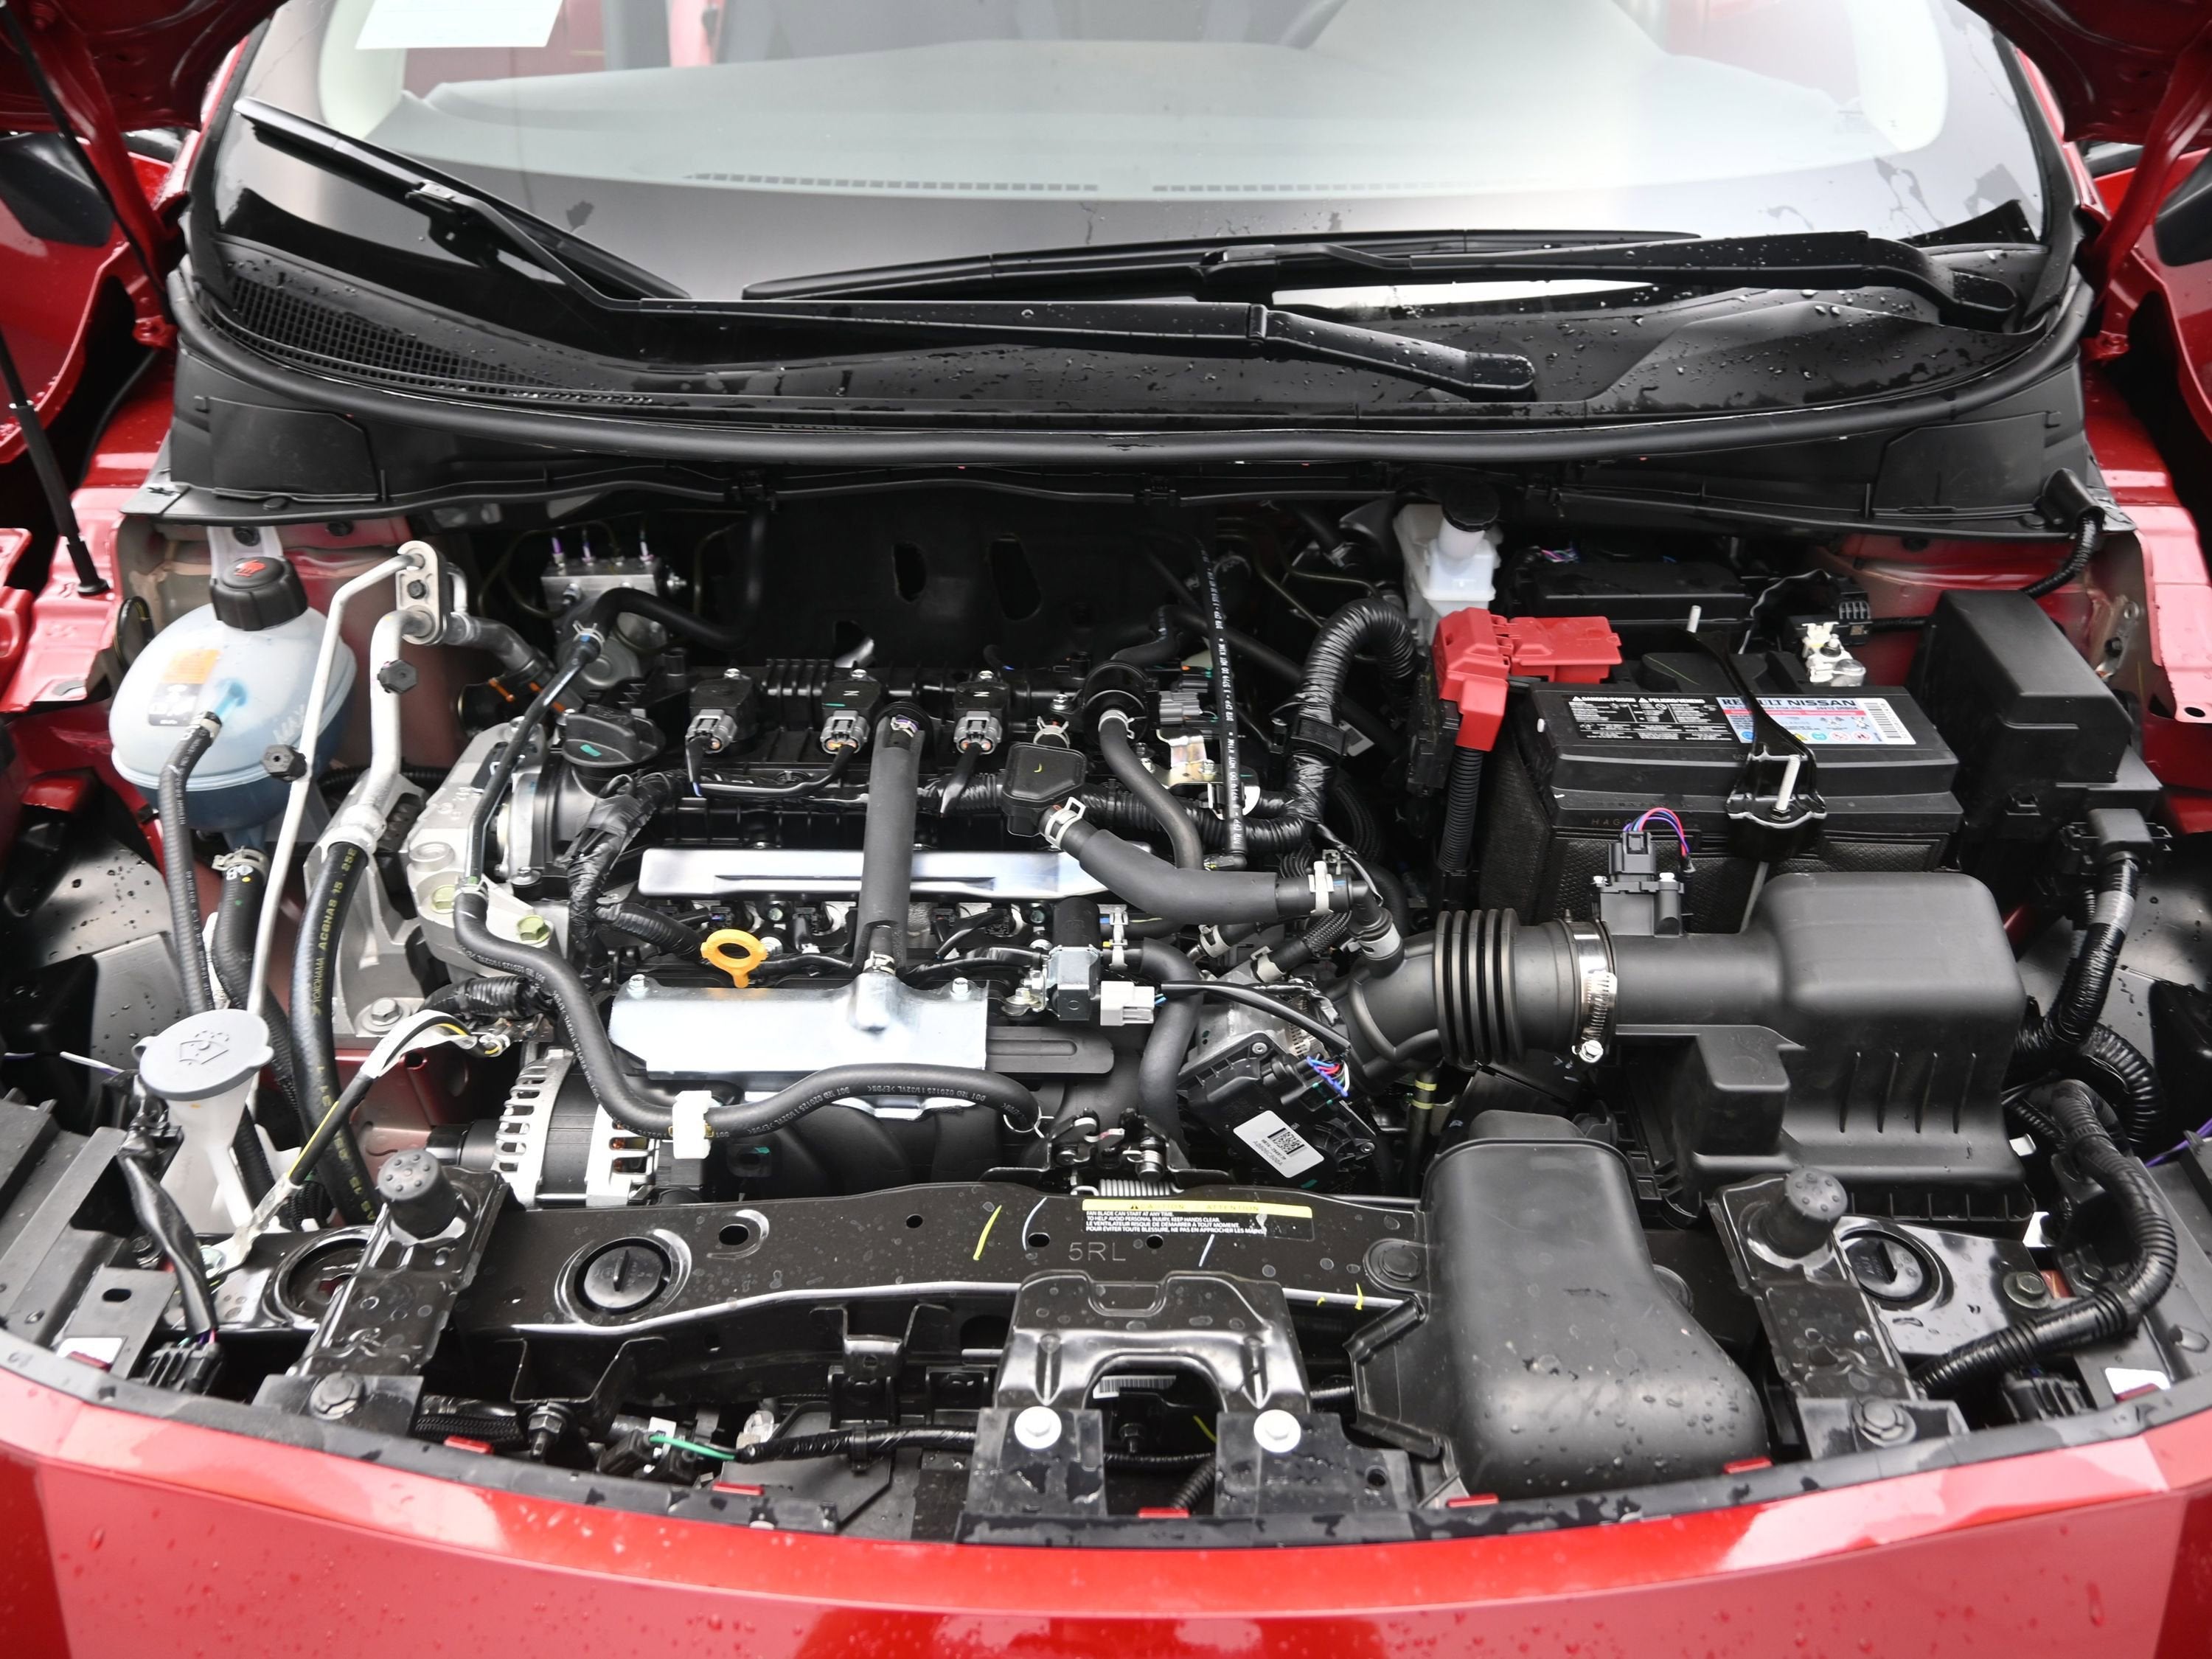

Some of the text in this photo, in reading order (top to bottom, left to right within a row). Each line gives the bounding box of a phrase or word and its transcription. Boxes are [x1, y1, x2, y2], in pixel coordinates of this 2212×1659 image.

[1228, 756, 1237, 769] NOT
[312, 958, 325, 1003] YOKOHAMA
[332, 881, 344, 894] 15
[928, 1087, 955, 1096] 020125
[971, 1093, 987, 1102] DOT
[1068, 1242, 1126, 1261] 5RL
